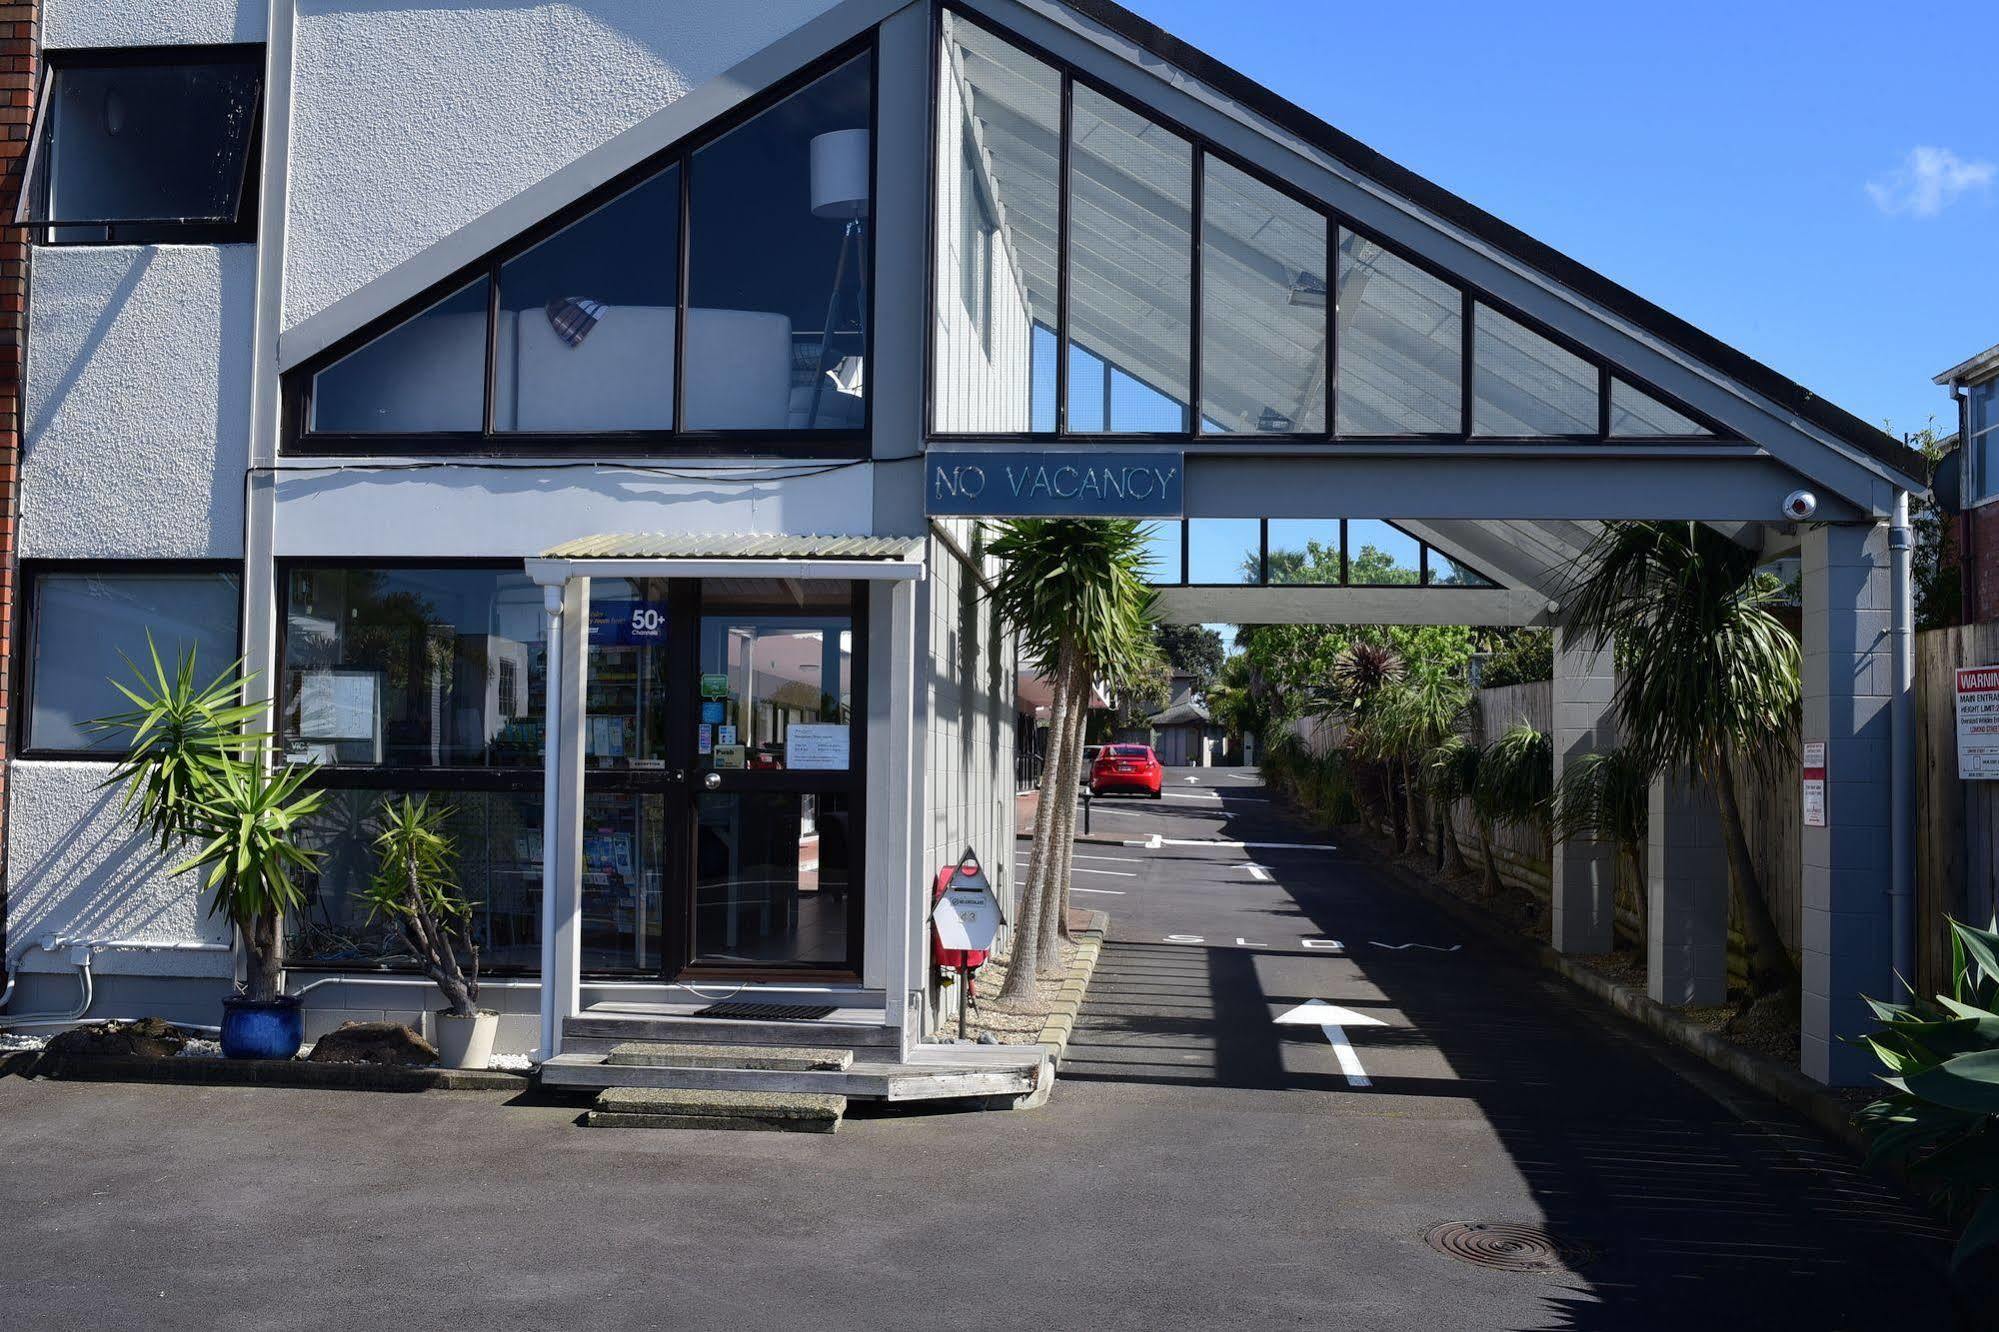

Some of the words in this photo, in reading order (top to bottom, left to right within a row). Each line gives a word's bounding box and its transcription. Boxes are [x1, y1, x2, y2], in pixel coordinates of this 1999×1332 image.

[935, 464, 986, 500] NO
[1006, 464, 1176, 500] VACANCY
[631, 609, 666, 630] 50+
[1960, 694, 1976, 703] MAIN
[1961, 705, 1979, 713] HEIGHT
[1162, 934, 1463, 952] SLOW
